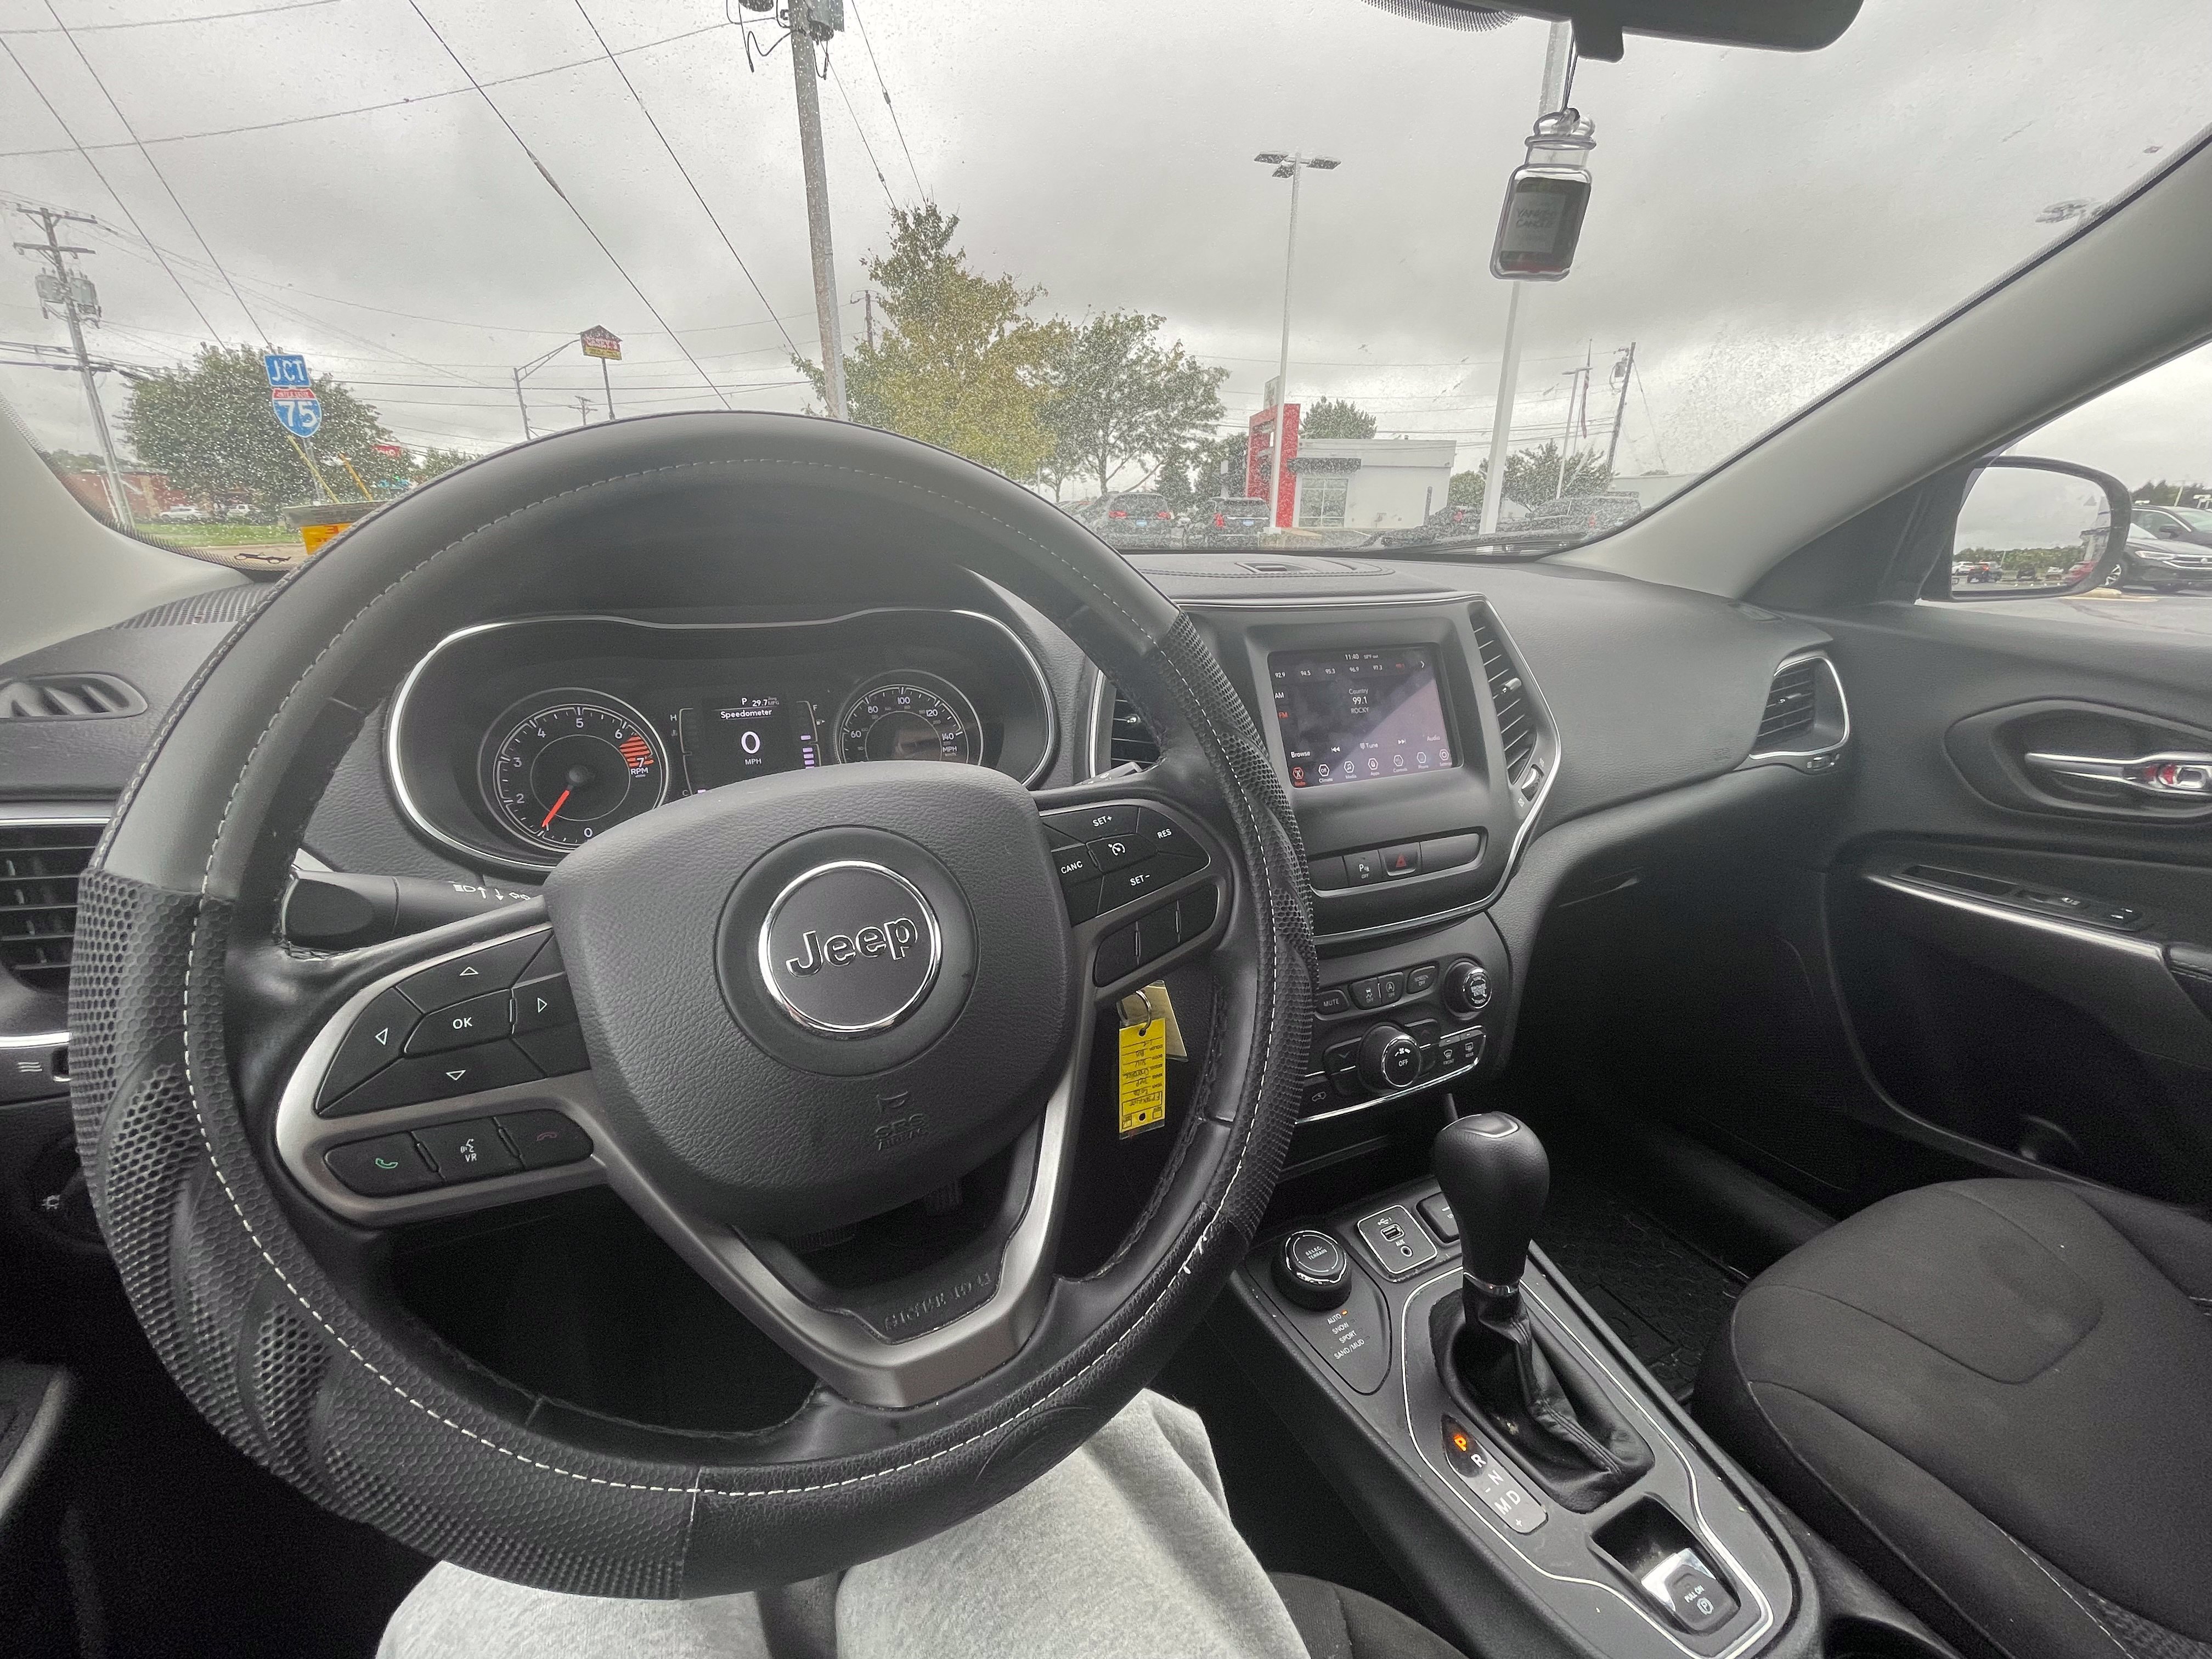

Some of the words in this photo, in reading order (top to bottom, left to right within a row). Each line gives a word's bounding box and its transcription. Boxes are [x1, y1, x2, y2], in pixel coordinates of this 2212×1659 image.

[272, 360, 306, 382] JCT
[278, 400, 318, 428] 75
[741, 697, 747, 706] P
[752, 699, 768, 707] 29.7
[897, 696, 910, 704] 100
[1352, 696, 1368, 705] 99.1
[720, 709, 772, 720] Speedometer
[926, 709, 938, 717] 120
[576, 718, 584, 729] 5
[537, 727, 546, 738] 4
[614, 729, 623, 739] 6
[850, 730, 861, 738] 60
[941, 732, 954, 741] 140
[741, 731, 760, 754] 0
[513, 757, 522, 768] 3
[636, 757, 645, 768] 7
[516, 793, 525, 804] 2
[584, 827, 594, 838] 0
[1157, 828, 1172, 839] RES
[1060, 860, 1084, 874] CANC
[786, 917, 918, 978] Jeep
[1323, 998, 1339, 1007] MUTE
[453, 1017, 473, 1029] OK
[1398, 1058, 1408, 1066] OFF
[465, 1153, 477, 1162] VR
[1395, 1239, 1406, 1247] AUX
[1327, 1313, 1342, 1325] AUTO
[1331, 1322, 1349, 1335] SNOW
[1339, 1330, 1357, 1344] SPORT
[1334, 1339, 1365, 1359] SAND/MUD
[1454, 1434, 1467, 1452] P
[1470, 1454, 1487, 1468] R
[1487, 1470, 1504, 1486] N
[1505, 1490, 1521, 1505] D
[1494, 1497, 1513, 1515] M
